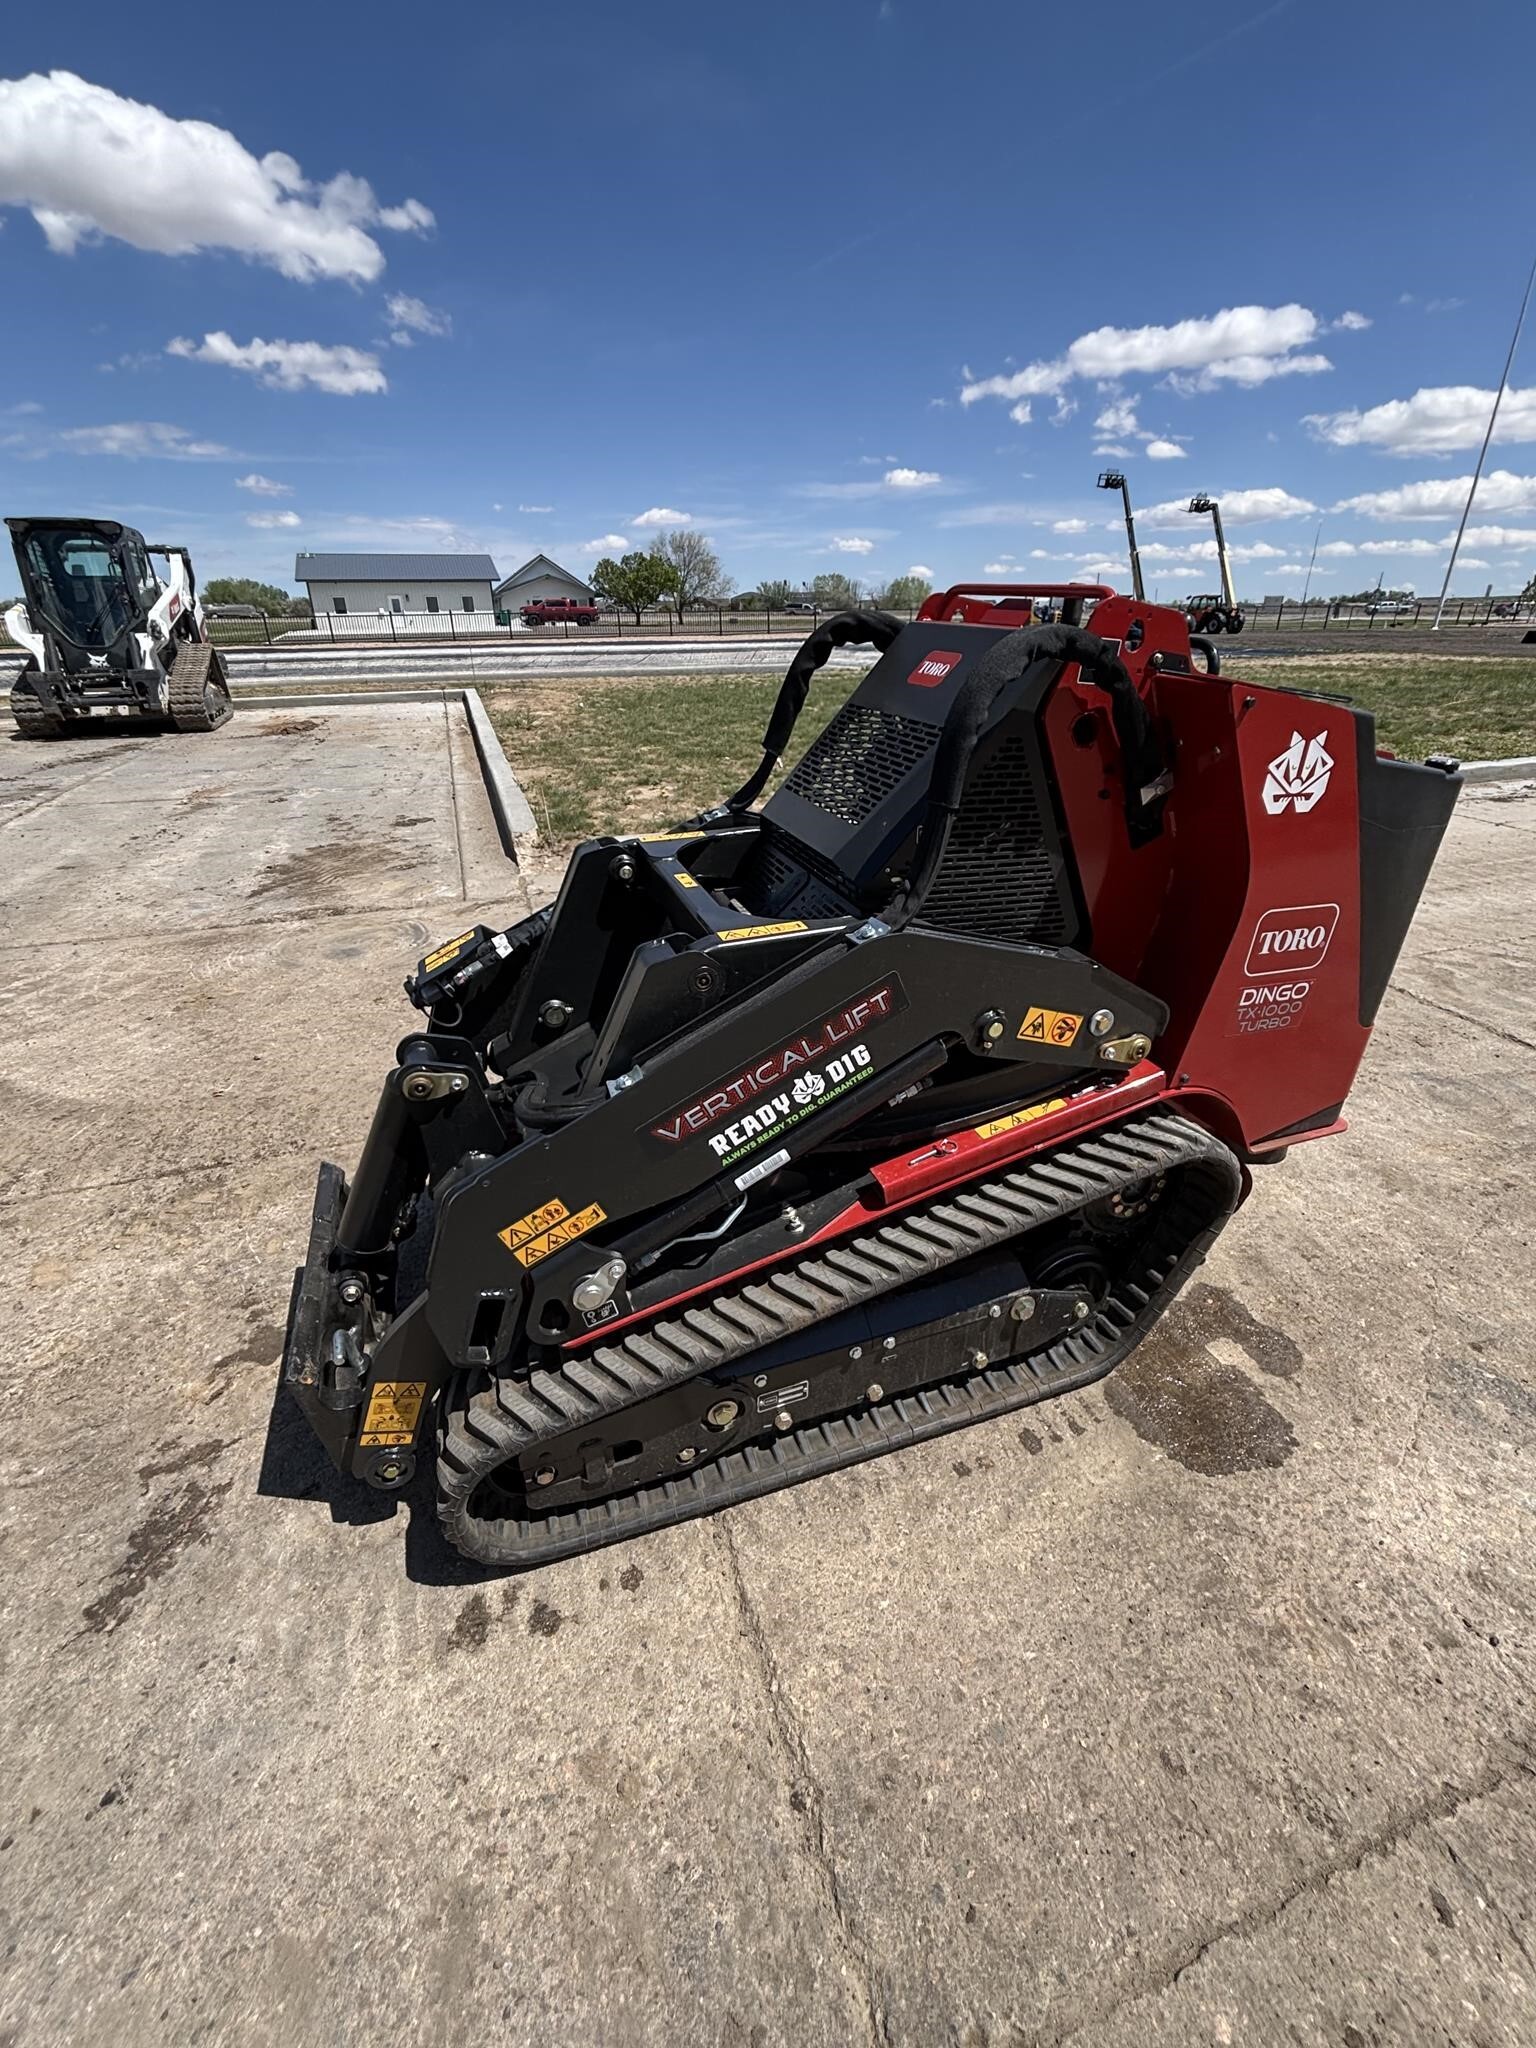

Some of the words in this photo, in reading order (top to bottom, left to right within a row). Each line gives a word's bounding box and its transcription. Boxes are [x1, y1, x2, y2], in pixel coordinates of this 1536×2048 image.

[918, 661, 950, 677] TORO
[1259, 926, 1325, 954] TORO
[1239, 983, 1310, 1006] DINGO
[1240, 1016, 1291, 1032] TURBO
[657, 1040, 824, 1140] VERTICAL
[826, 990, 889, 1042] LIFT
[708, 1093, 791, 1156] READY
[825, 1044, 871, 1083] DIG
[722, 1141, 757, 1167] ALWAYS
[757, 1122, 786, 1145] READY
[786, 1113, 799, 1124] TO
[818, 1066, 874, 1105] GUARANTEED
